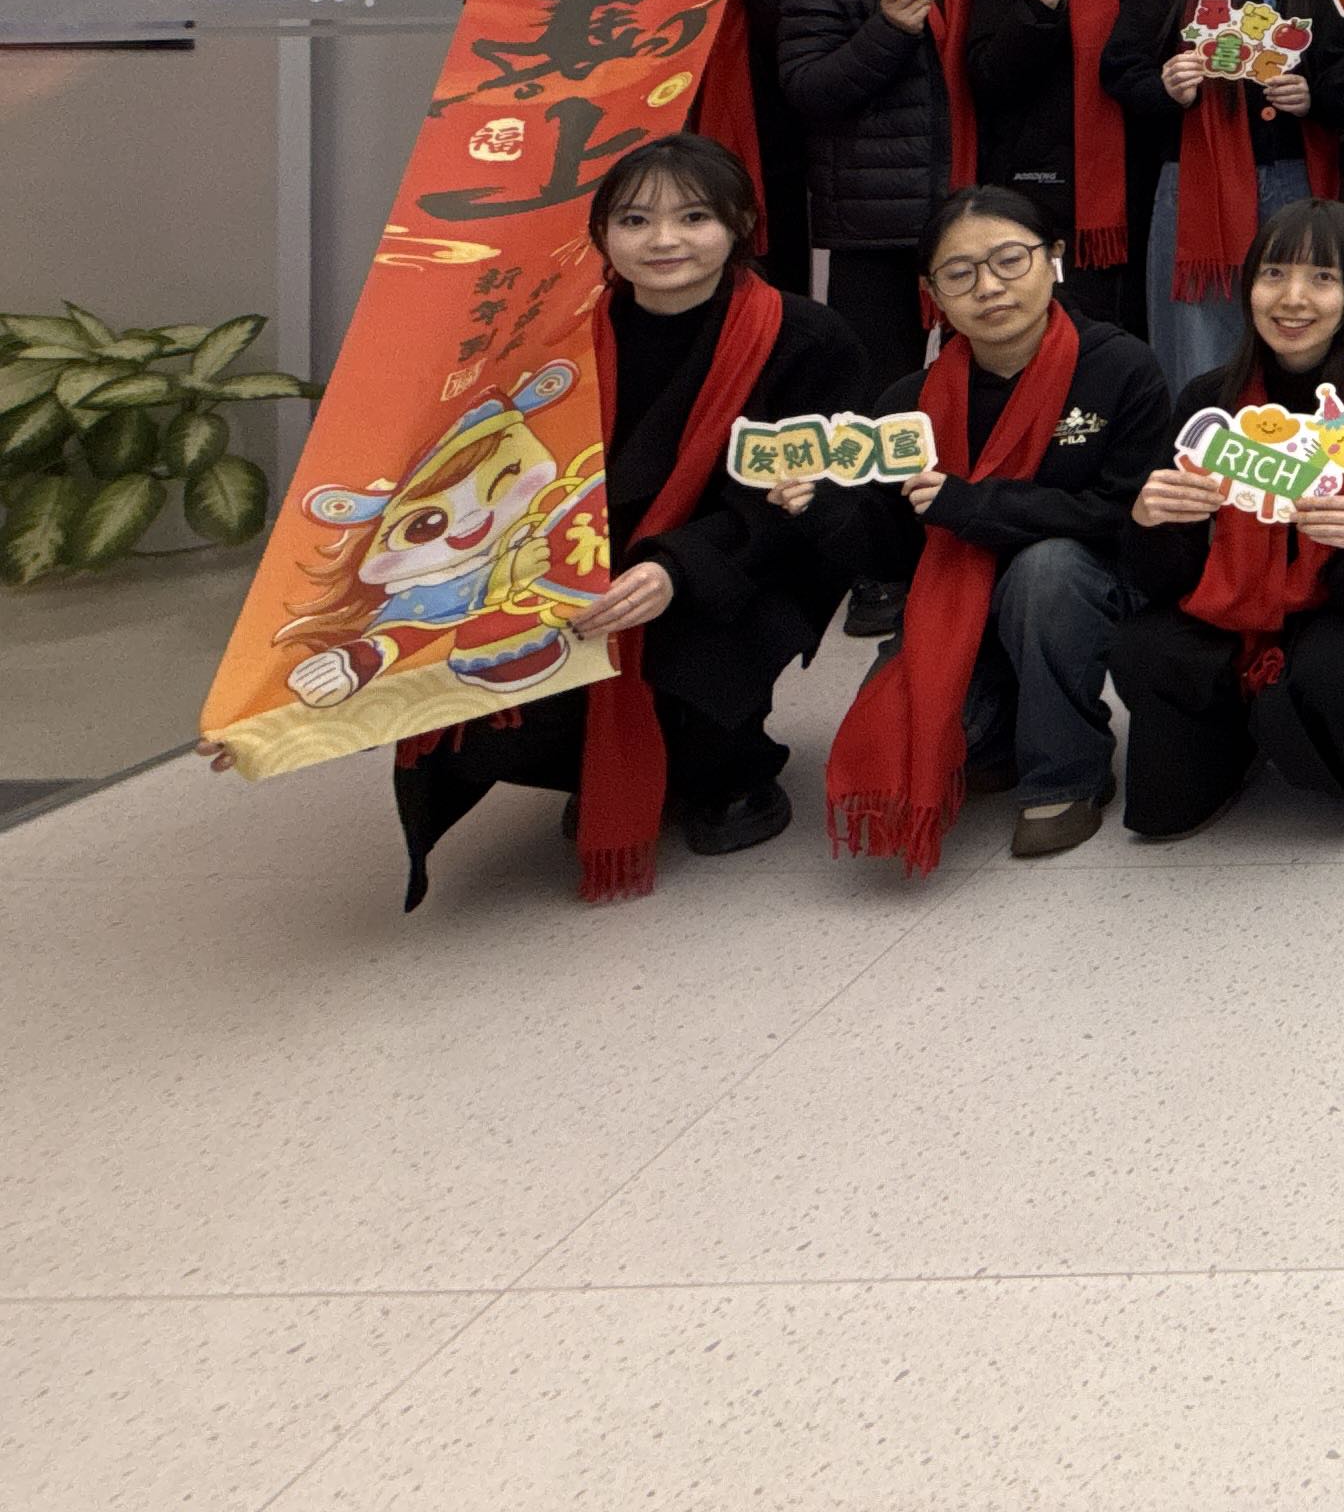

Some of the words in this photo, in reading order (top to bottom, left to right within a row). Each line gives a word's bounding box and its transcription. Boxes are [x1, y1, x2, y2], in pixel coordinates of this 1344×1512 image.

[470, 125, 523, 157] 福
[748, 429, 921, 474] 发财暴富
[1216, 438, 1301, 490] RICH
